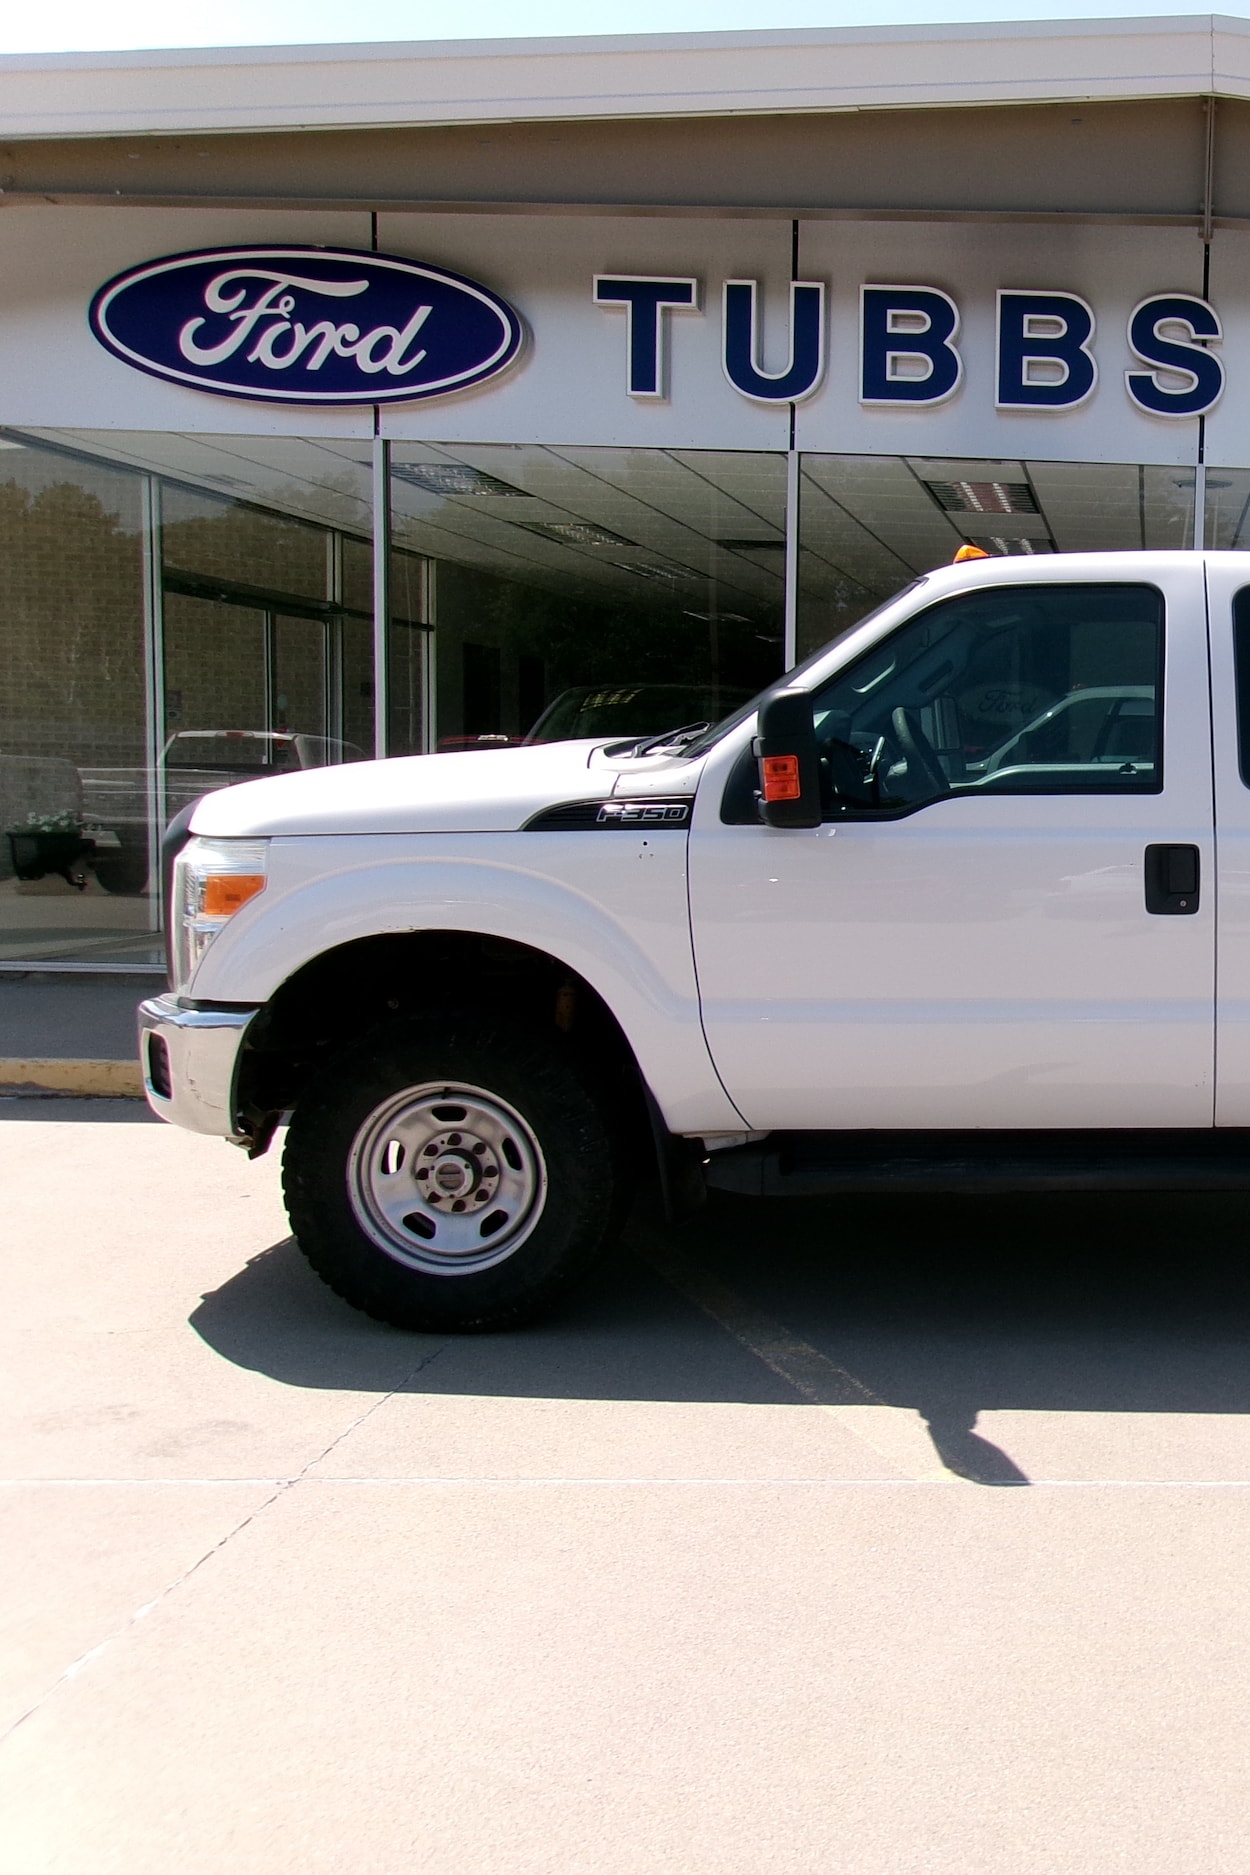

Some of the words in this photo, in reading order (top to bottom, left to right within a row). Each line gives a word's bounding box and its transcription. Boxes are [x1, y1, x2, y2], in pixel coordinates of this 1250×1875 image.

[179, 268, 432, 377] Ford
[592, 274, 1225, 419] TUBBS
[978, 689, 1038, 713] Ford
